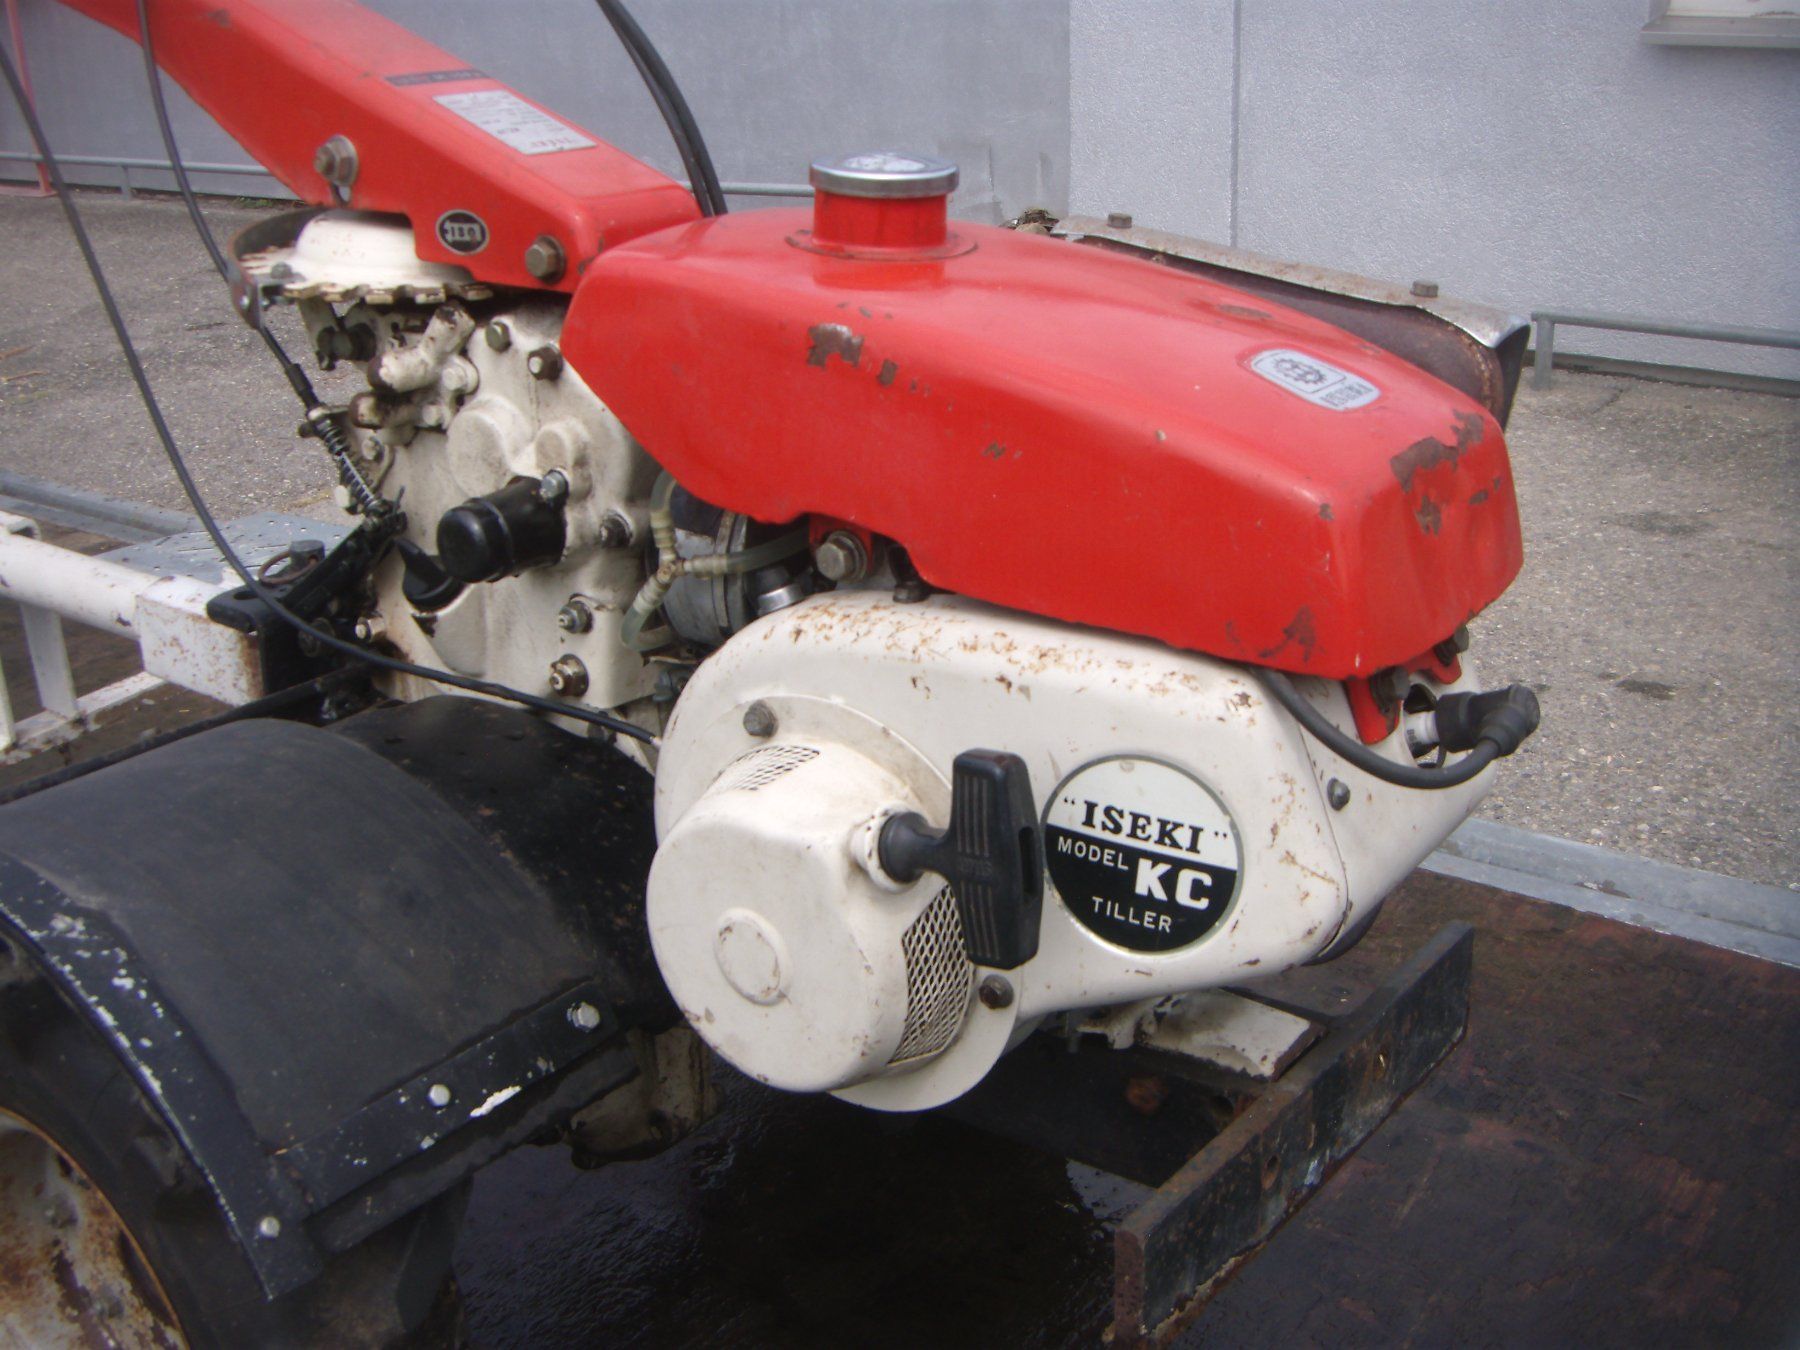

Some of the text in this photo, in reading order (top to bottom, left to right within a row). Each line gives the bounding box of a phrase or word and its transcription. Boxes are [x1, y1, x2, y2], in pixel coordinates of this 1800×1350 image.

[1057, 835, 1213, 911] MODEL KC
[1091, 895, 1174, 934] TILLER
